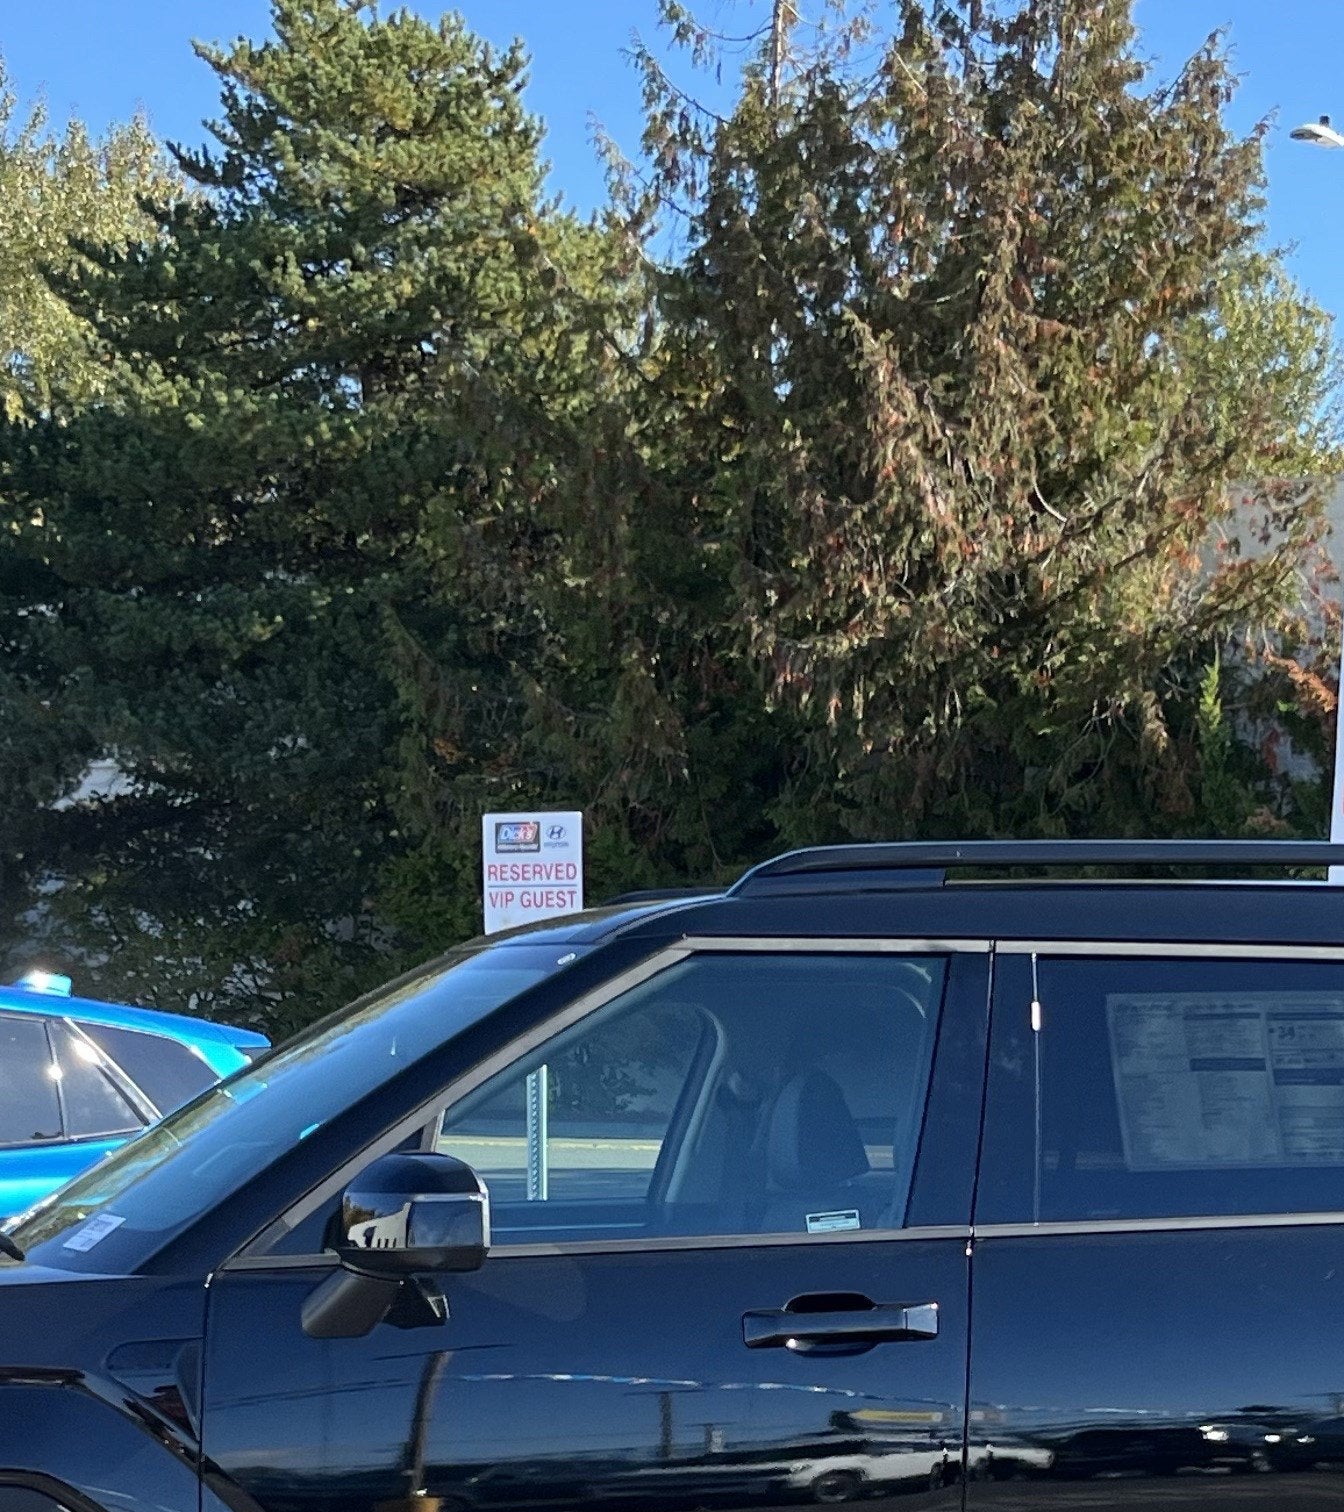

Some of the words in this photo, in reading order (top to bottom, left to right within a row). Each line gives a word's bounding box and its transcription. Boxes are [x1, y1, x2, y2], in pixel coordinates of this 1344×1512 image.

[487, 863, 578, 881] RESERVED
[489, 891, 515, 908] VIP
[520, 890, 577, 908] GUEST
